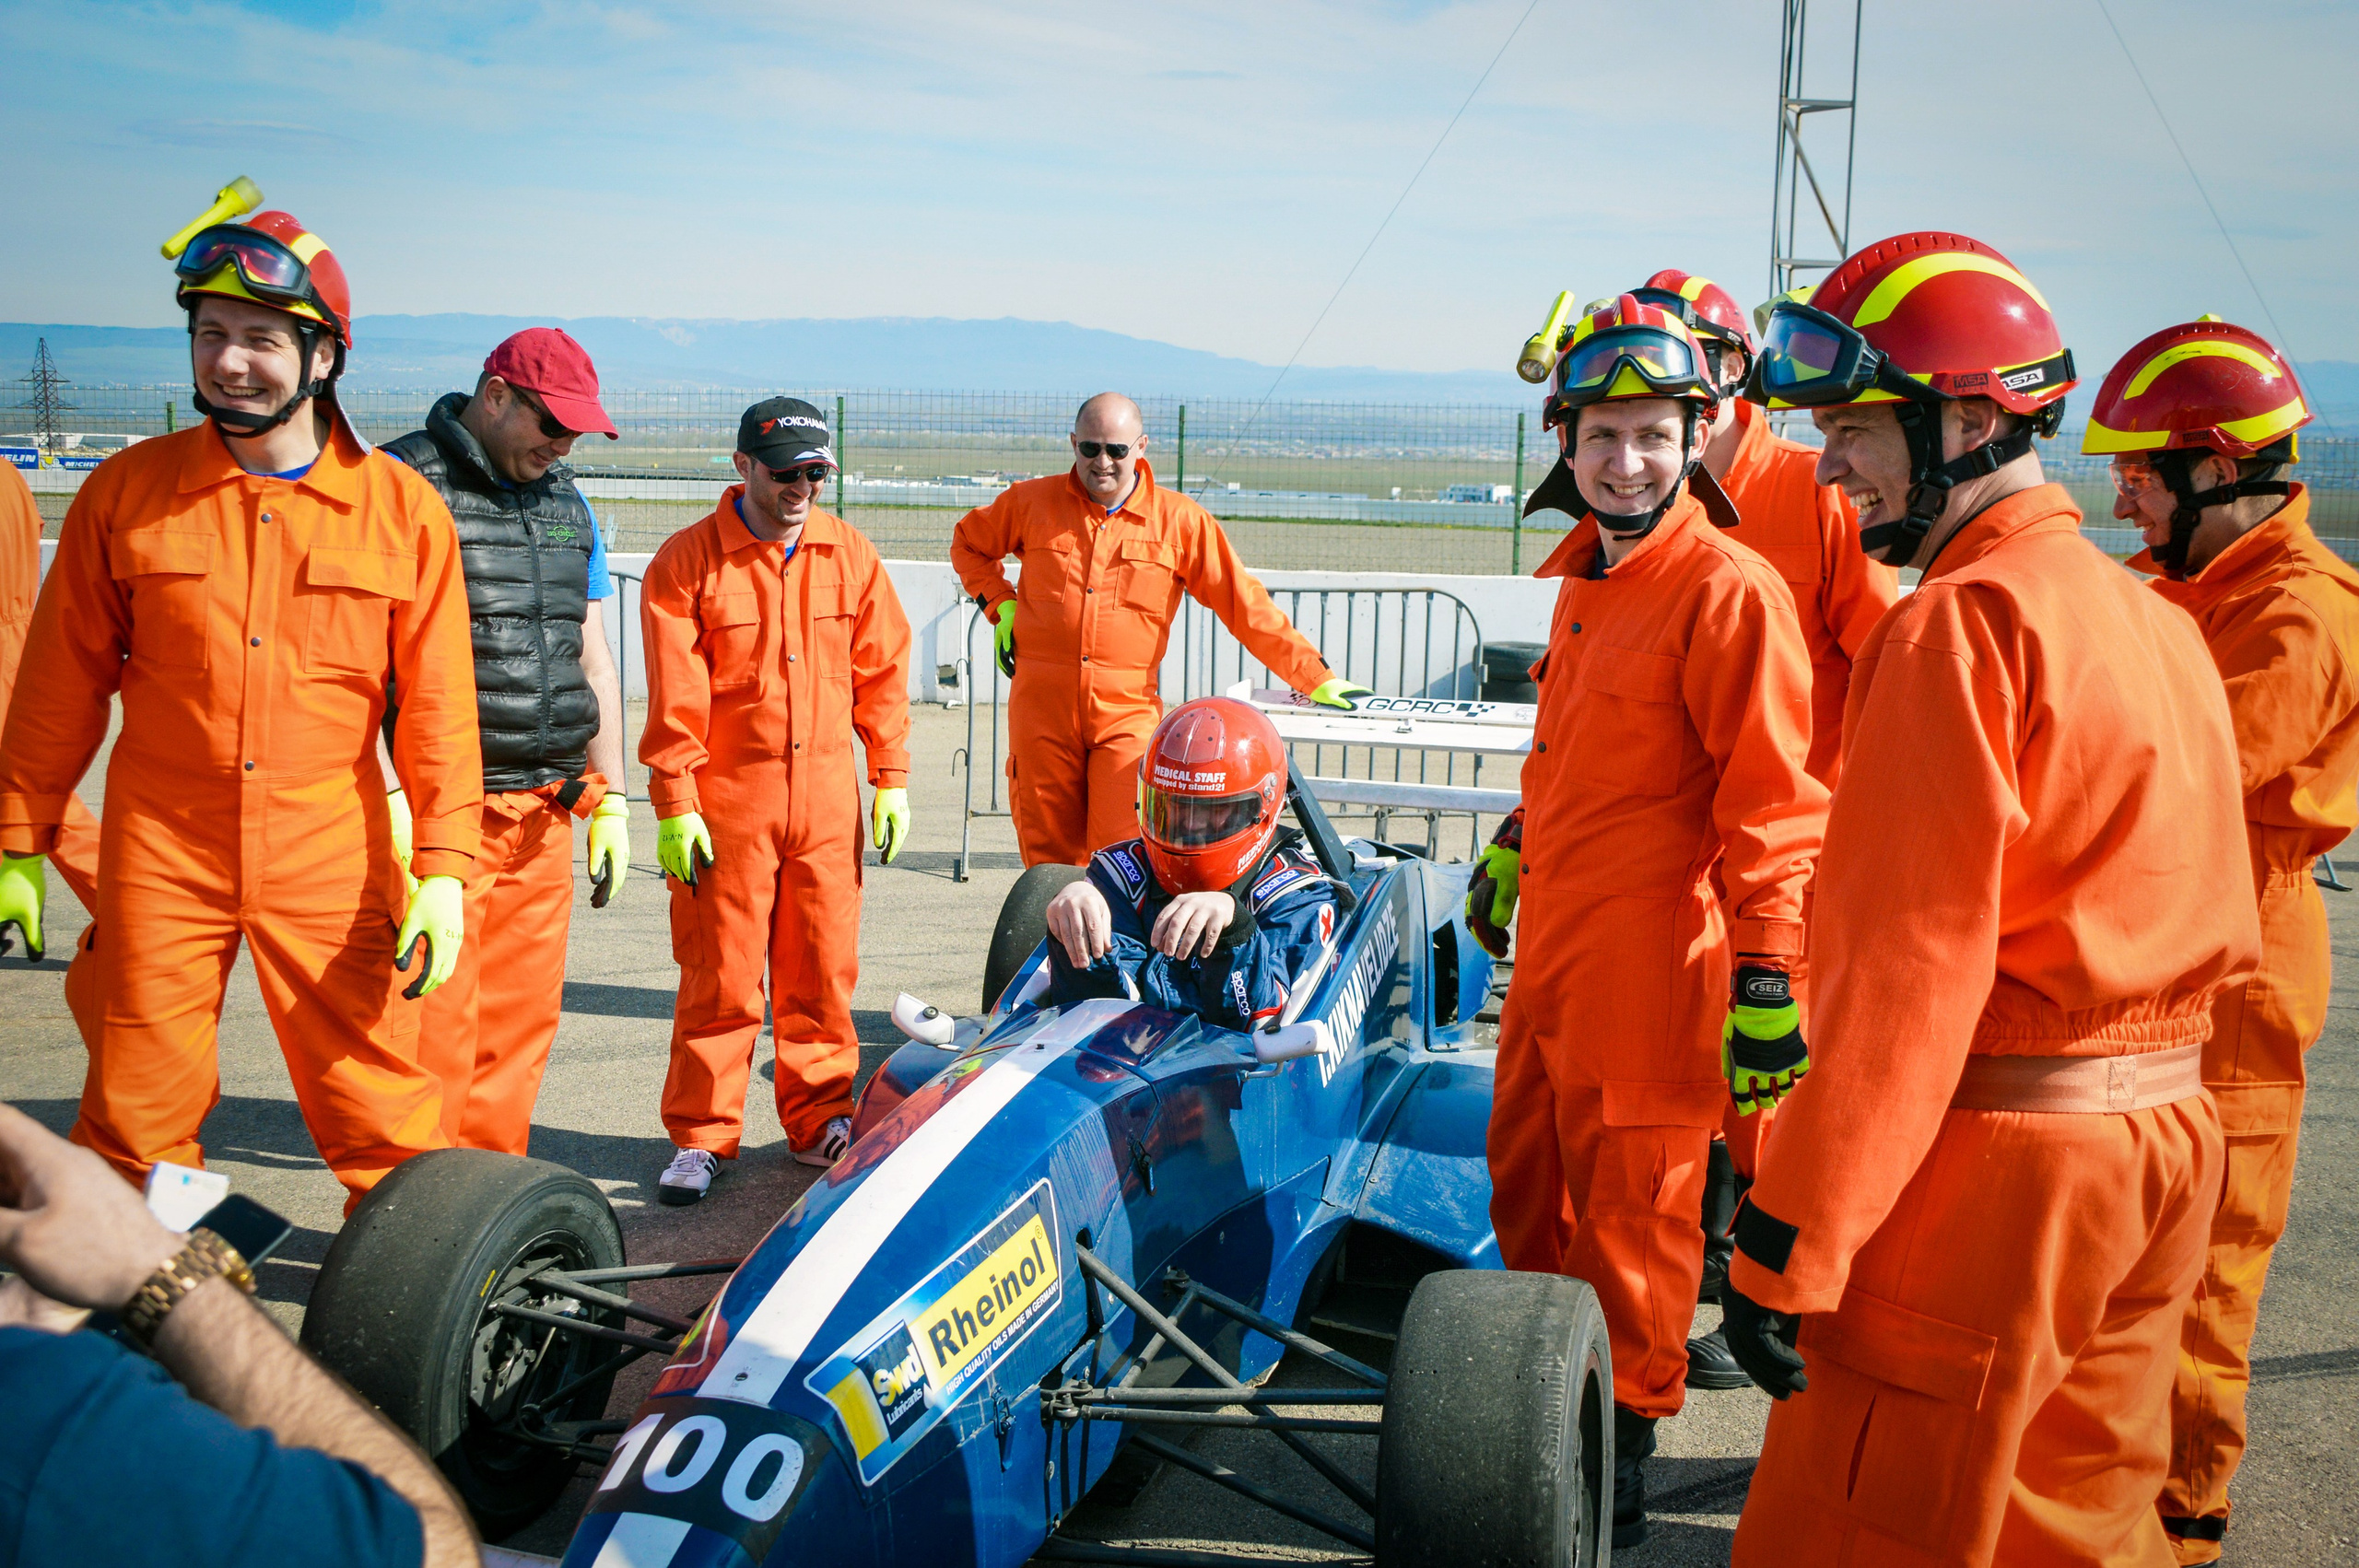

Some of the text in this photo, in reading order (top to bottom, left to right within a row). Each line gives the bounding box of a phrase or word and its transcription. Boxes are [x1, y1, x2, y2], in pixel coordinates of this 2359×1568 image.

[1954, 373, 1988, 387] MSA
[1155, 765, 1226, 783] MEDICAL STAFF
[1178, 781, 1187, 790] by
[1188, 783, 1226, 792] stand21
[1112, 850, 1141, 883] sparco
[1255, 870, 1299, 899] sparco
[1231, 970, 1251, 1017] sparco
[1758, 984, 1783, 992] SEIZ
[928, 1236, 1046, 1369] Rheinol
[945, 1279, 1059, 1396] HIGH QUALITY OILS MADE IN GERMANY
[886, 1387, 923, 1426] Lubricants
[598, 1412, 805, 1523] 100
